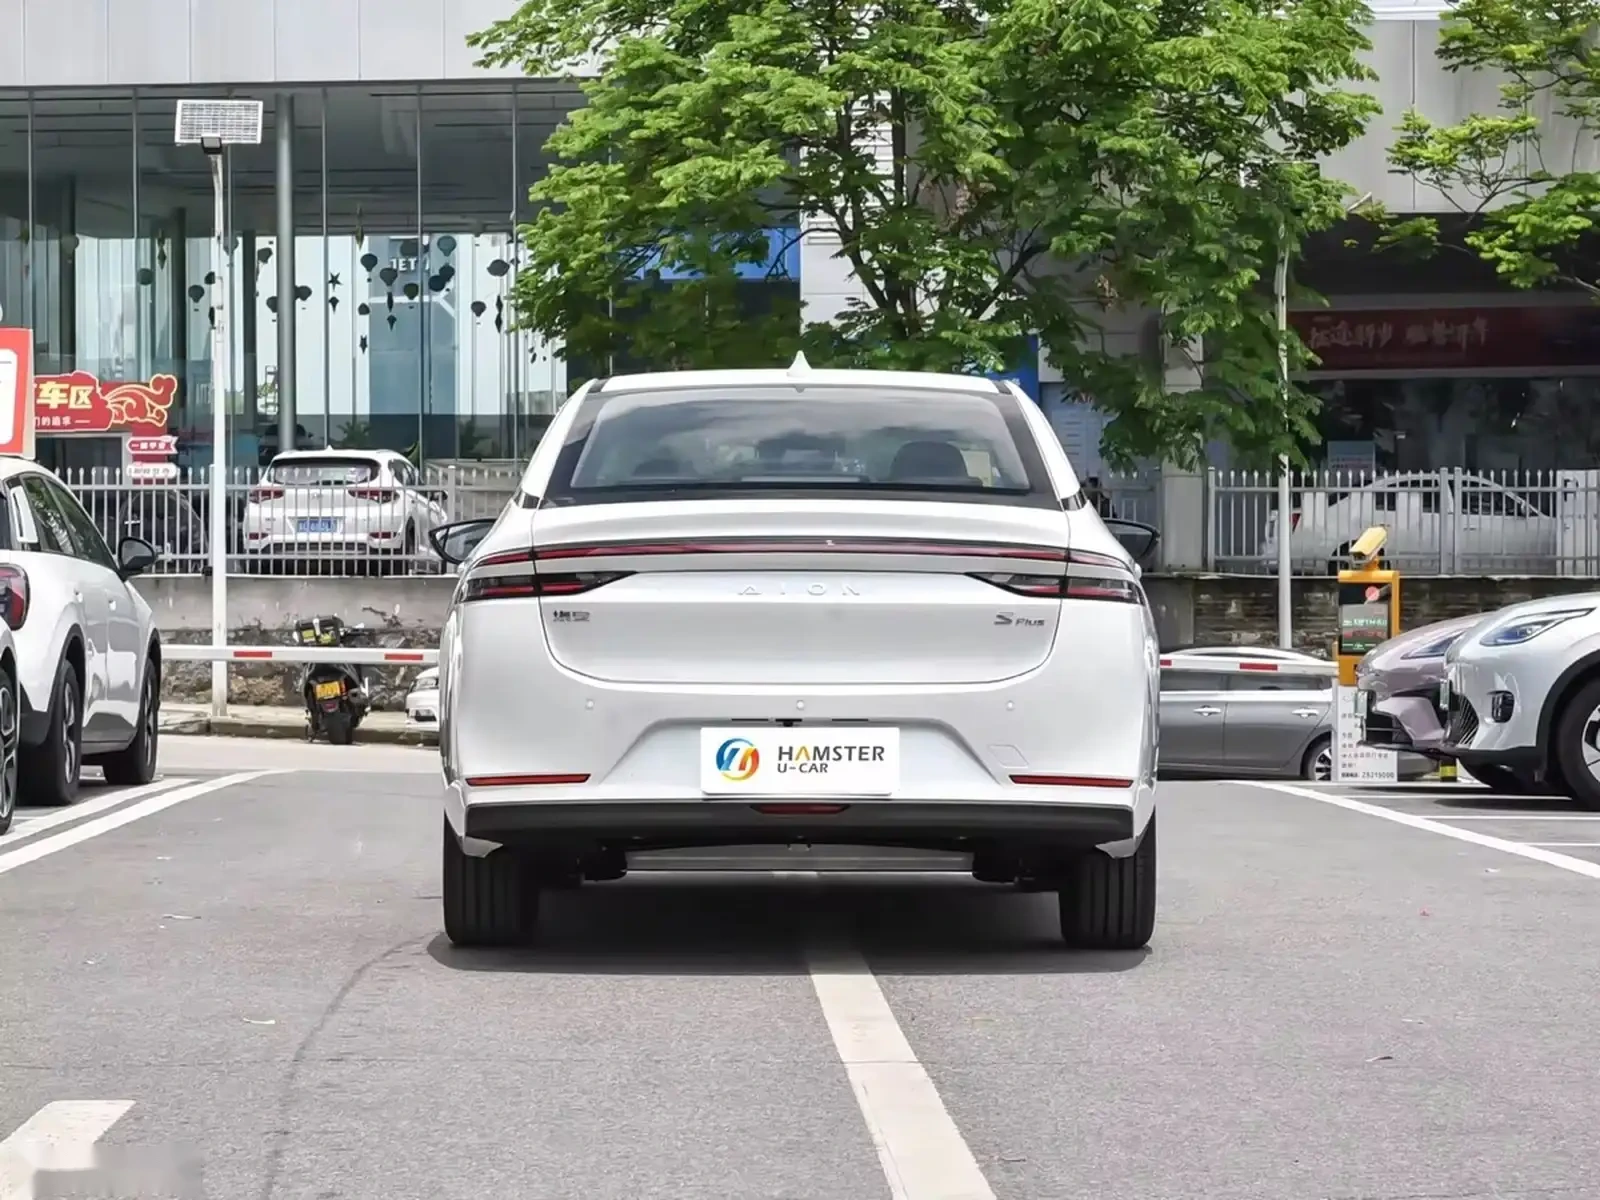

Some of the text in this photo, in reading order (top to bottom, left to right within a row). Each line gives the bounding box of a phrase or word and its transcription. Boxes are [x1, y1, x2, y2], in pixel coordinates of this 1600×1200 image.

[33, 381, 94, 409] 车区
[738, 583, 861, 597] AION
[1015, 618, 1045, 627] Plus
[778, 745, 885, 762] HAMSTER
[777, 762, 829, 774] U-CAR
